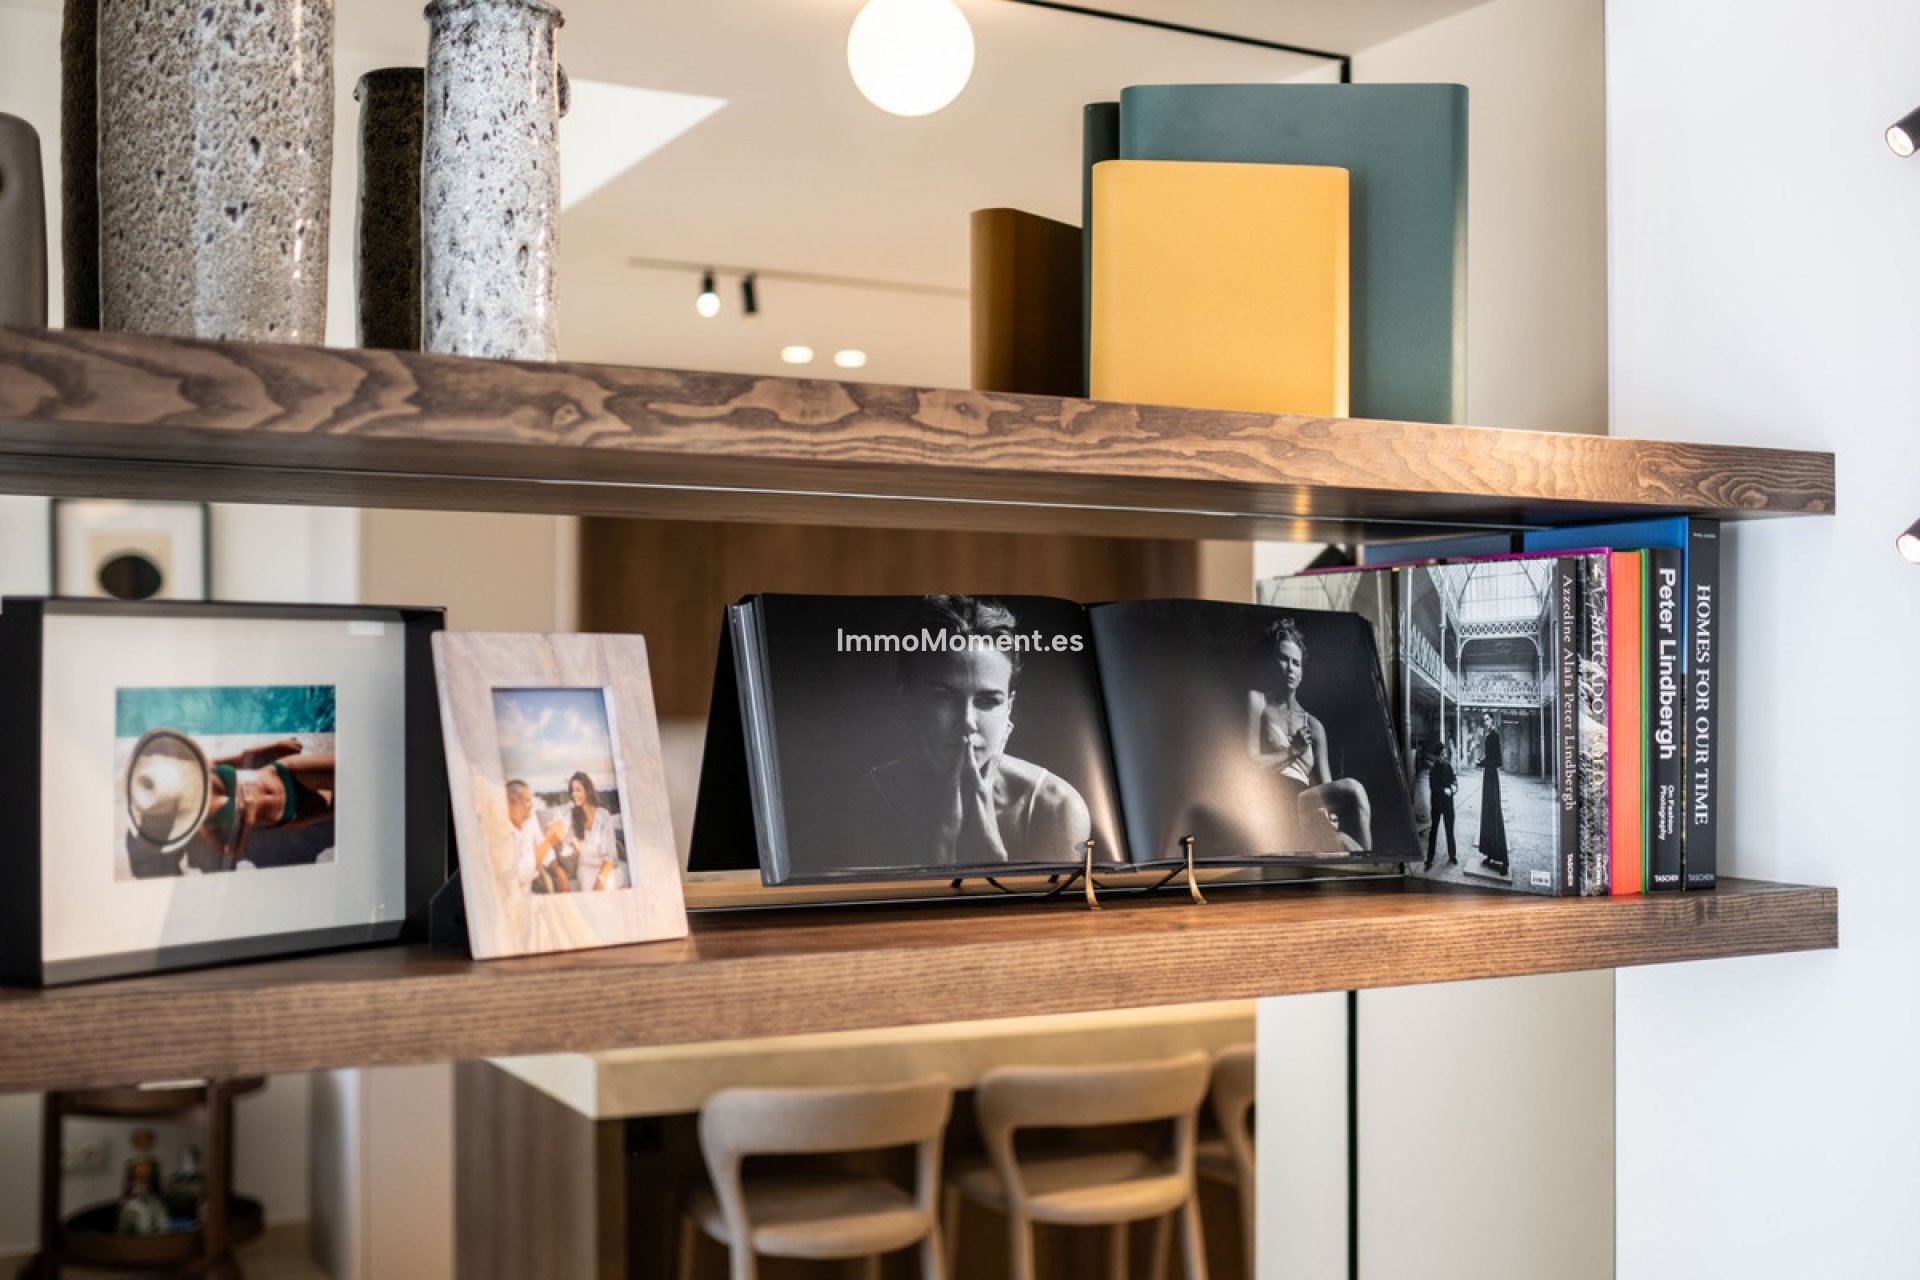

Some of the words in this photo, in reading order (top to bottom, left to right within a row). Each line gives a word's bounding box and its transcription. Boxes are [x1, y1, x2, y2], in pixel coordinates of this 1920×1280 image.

[1563, 574, 1575, 642] Azzedine
[1659, 568, 1676, 633] Peter
[1695, 584, 1711, 663] HOMES
[1564, 648, 1575, 687] Alaïa
[1592, 615, 1604, 714] SALGADO
[1695, 669, 1710, 710] FOR
[1564, 693, 1575, 729] Peter
[1656, 640, 1677, 759] Lindbergh
[1695, 716, 1710, 763] OUR
[1562, 735, 1577, 810] Lindbergh
[1695, 768, 1710, 825] TIME
[1658, 785, 1667, 840] Photography
[1667, 799, 1675, 834] Fashion
[1654, 874, 1679, 882] TASCHEN
[1688, 873, 1714, 881] TASCHEN
